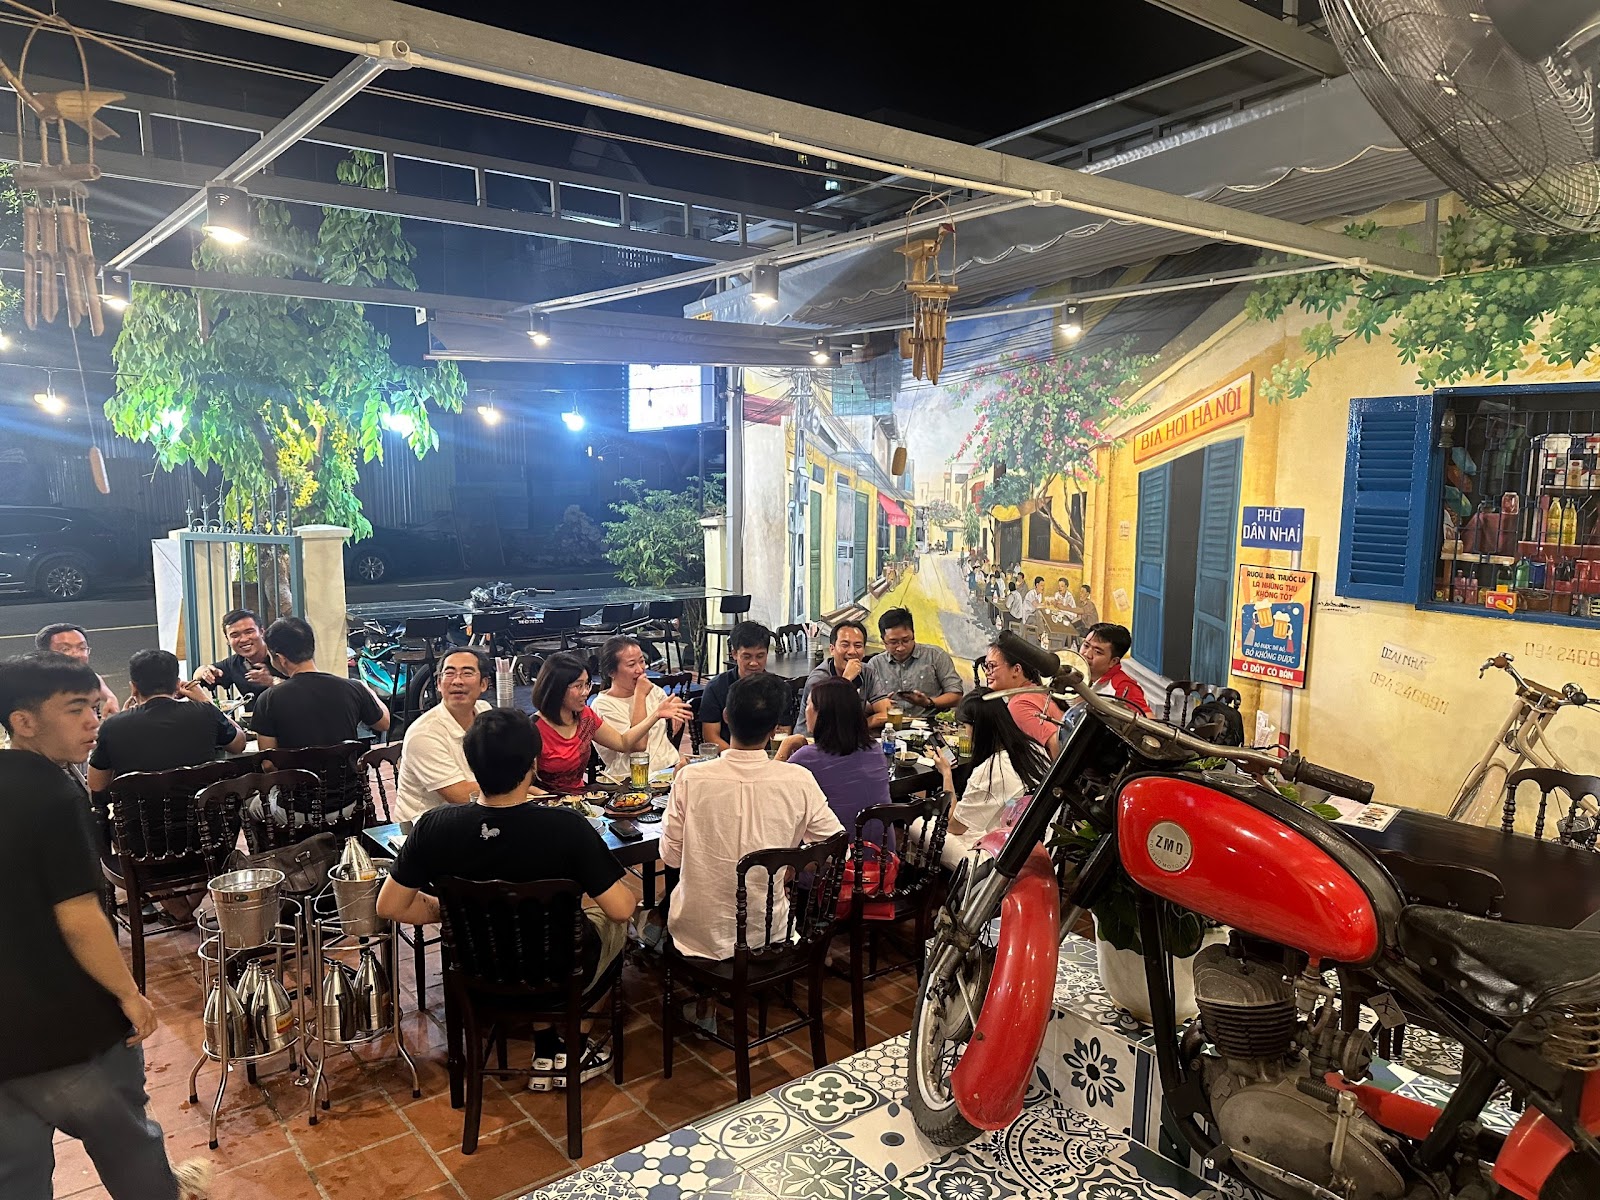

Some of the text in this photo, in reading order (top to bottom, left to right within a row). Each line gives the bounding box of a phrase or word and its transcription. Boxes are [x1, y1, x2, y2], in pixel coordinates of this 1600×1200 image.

[1141, 428, 1162, 451] BIA
[1166, 414, 1188, 441] HƠI
[1215, 386, 1242, 419] NỘI
[1257, 507, 1284, 523] PHỐ
[1243, 522, 1266, 540] DÂN
[1278, 573, 1297, 583] THUỐC
[1255, 590, 1278, 600] KHÔNG
[1245, 647, 1295, 664] BỎ KHÔNG ĐƯỢC
[1250, 663, 1265, 674] ĐÂY
[1266, 666, 1278, 677] CÓ
[1278, 669, 1294, 680] BÁN
[1155, 834, 1184, 856] ZMD
